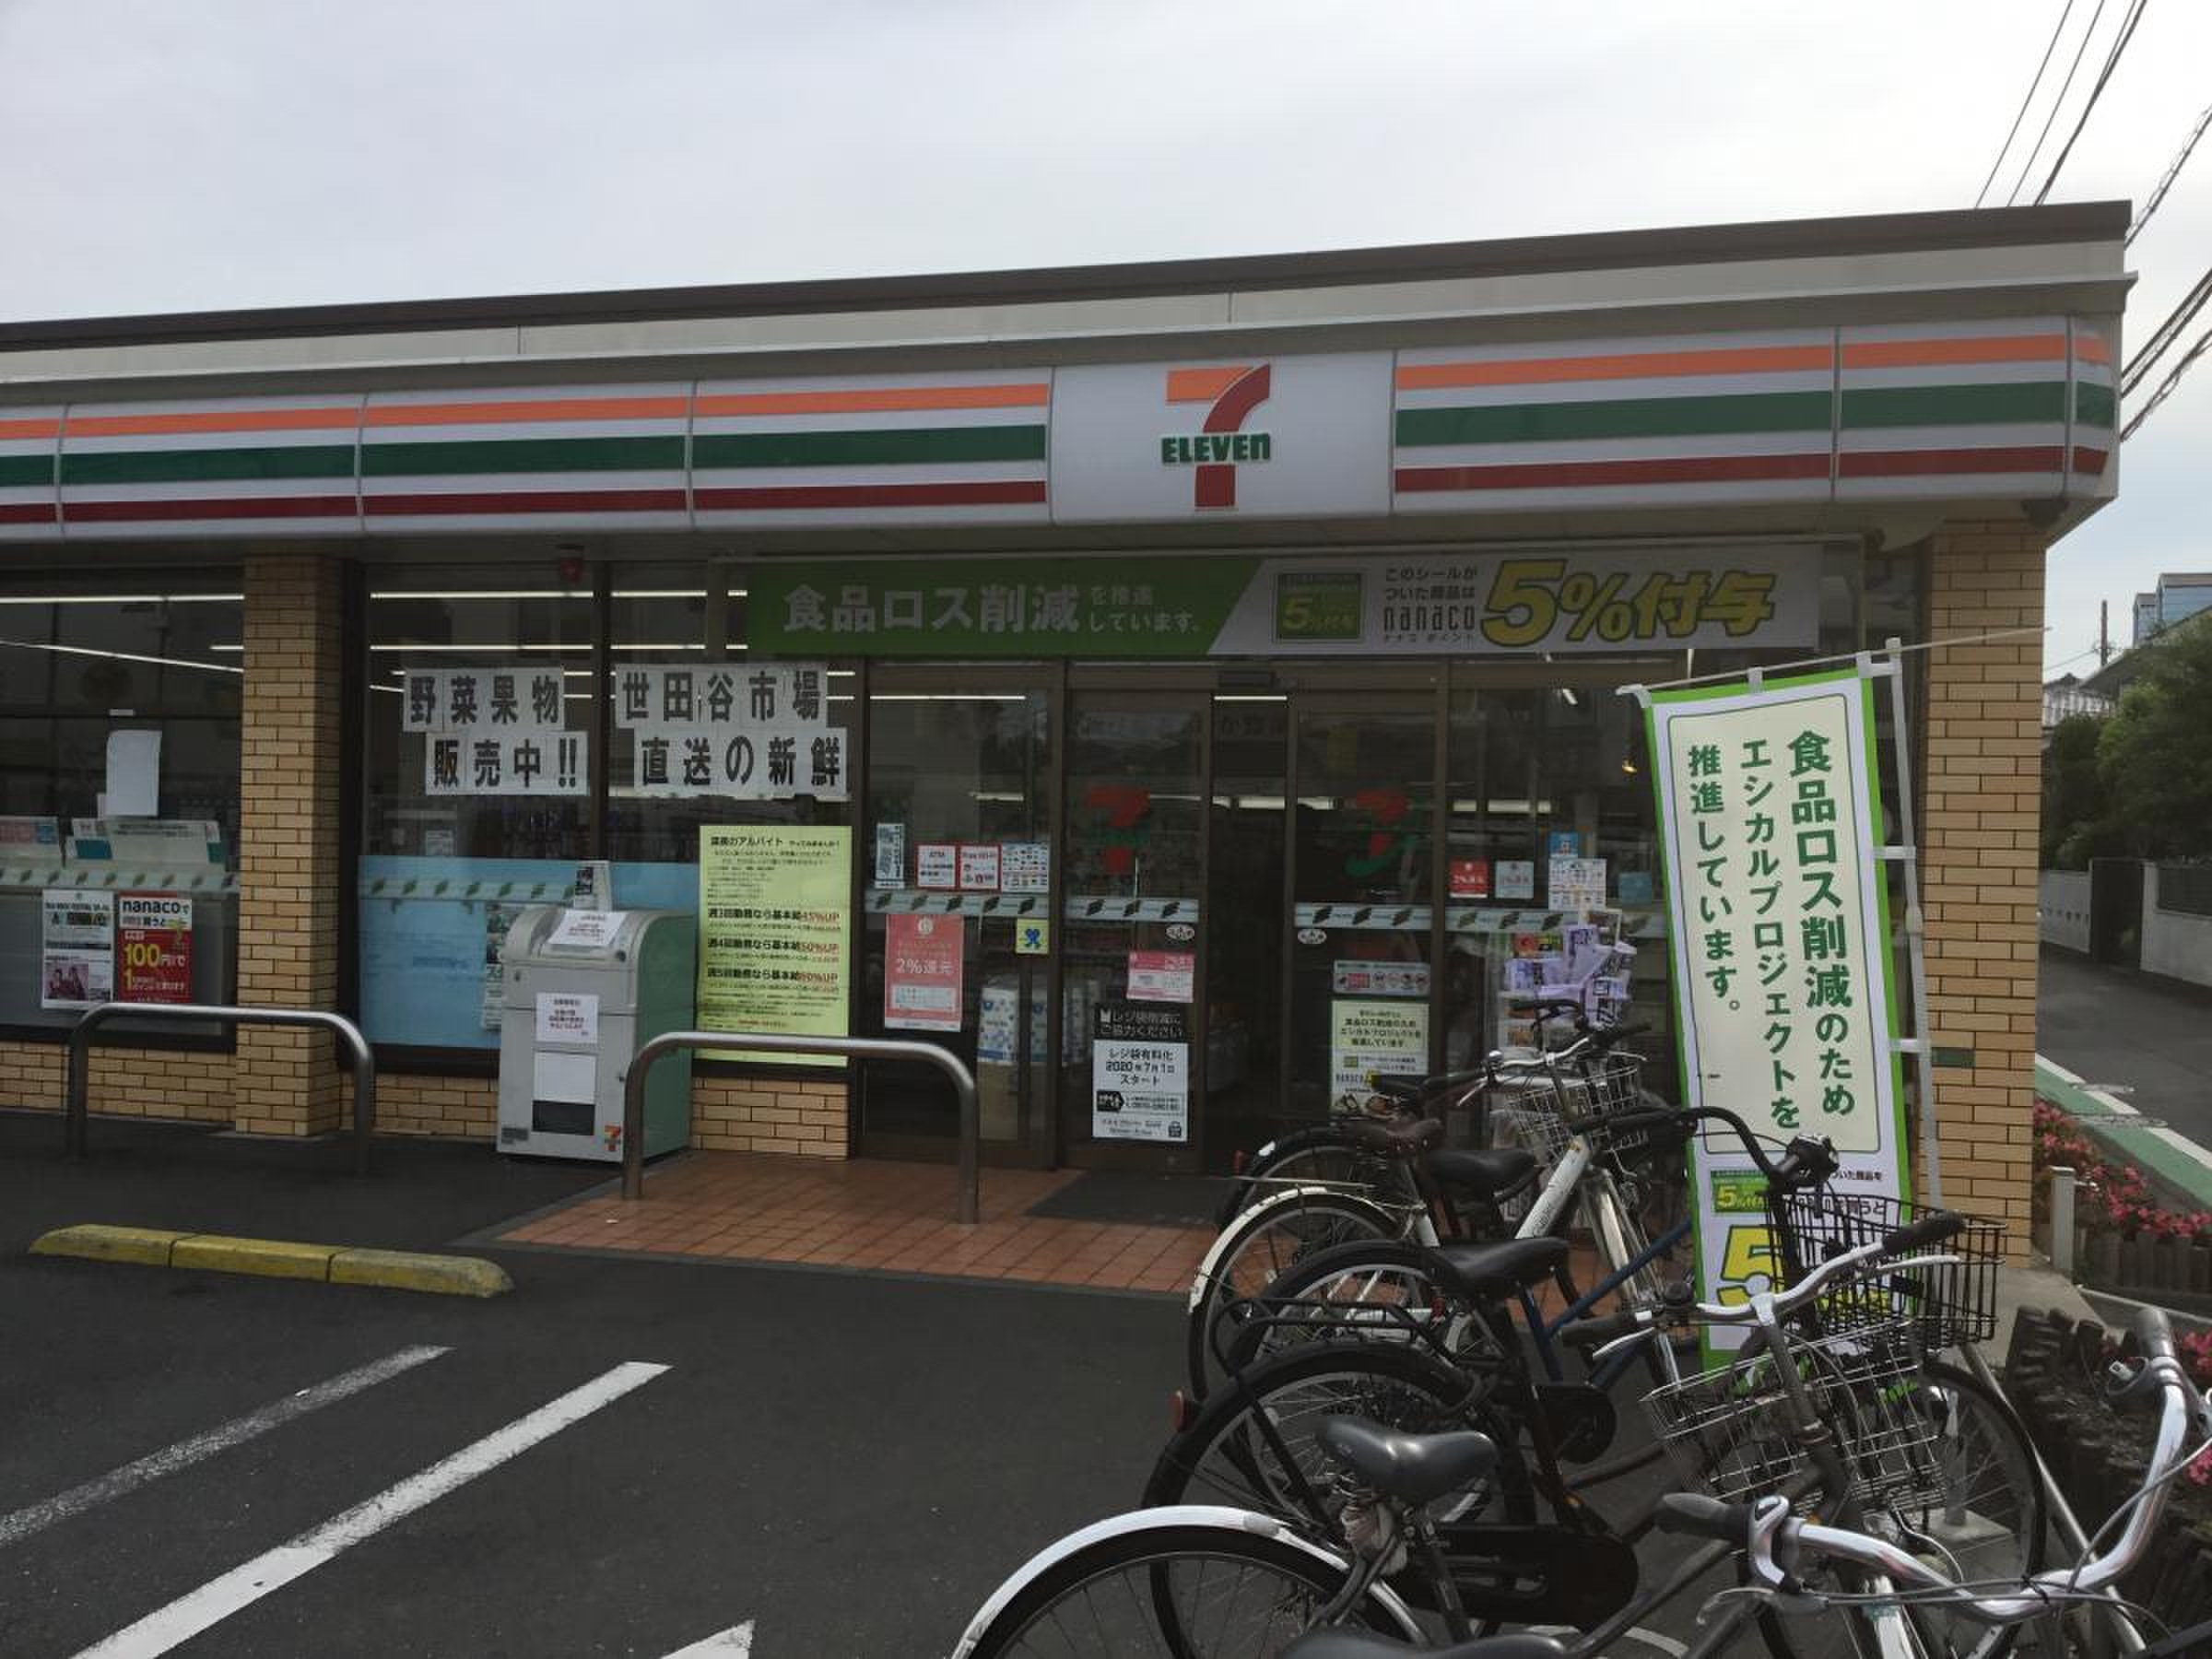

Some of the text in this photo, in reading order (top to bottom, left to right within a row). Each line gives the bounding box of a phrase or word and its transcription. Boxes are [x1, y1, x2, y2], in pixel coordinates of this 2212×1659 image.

[1166, 363, 1270, 508] 7
[783, 585, 1079, 633] 食品ロス削減
[1384, 606, 1475, 631] nanaco
[1480, 559, 1775, 647] 5%付与
[411, 676, 559, 724] 野菜果物
[623, 670, 821, 721] 世田谷市場
[641, 735, 841, 785] 直送の新鮮
[1688, 744, 1740, 1011] 推進しています。
[1741, 739, 1800, 1130] エシカルプロジェクトを
[1787, 730, 1855, 1116] 食品ロス削減のため
